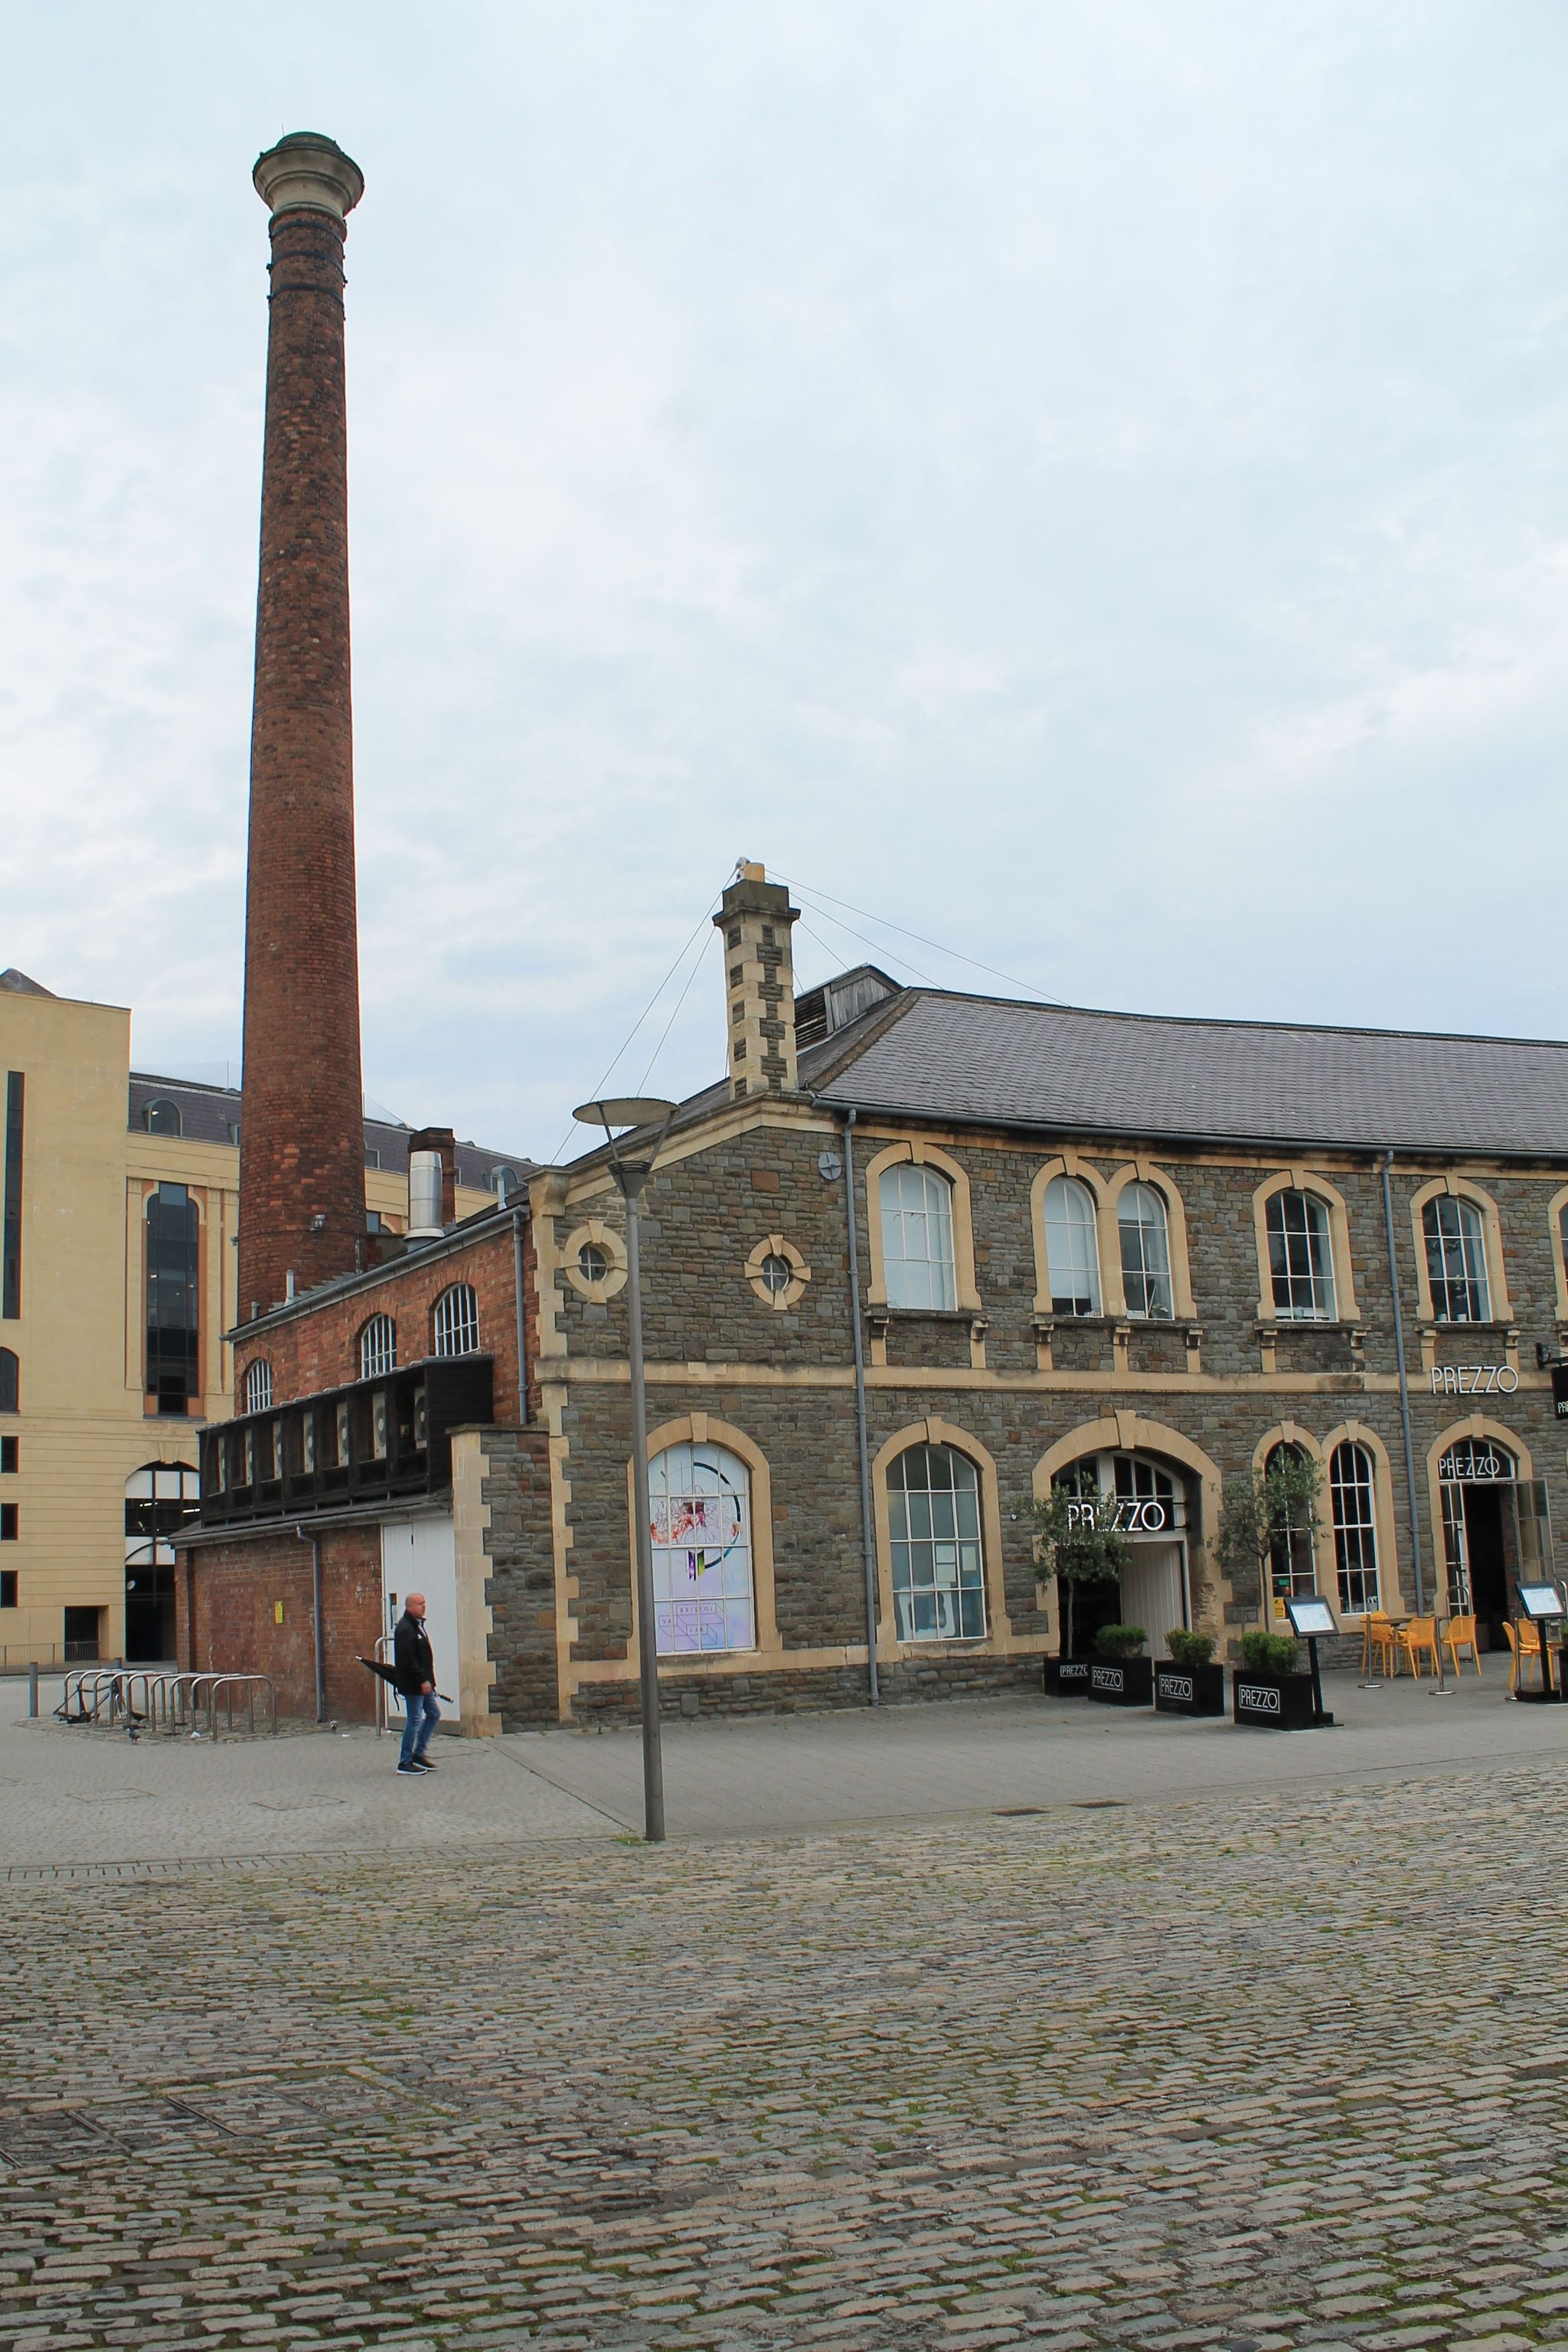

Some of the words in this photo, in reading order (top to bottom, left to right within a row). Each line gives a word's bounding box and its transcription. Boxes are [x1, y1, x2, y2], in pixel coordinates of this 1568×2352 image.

[1431, 1365, 1519, 1394] PREZZO
[1439, 1456, 1500, 1477] PREZZO
[1093, 1670, 1122, 1687] PREZZO
[1161, 1677, 1191, 1697] PREZZO
[1240, 1688, 1278, 1709] PREZZO
